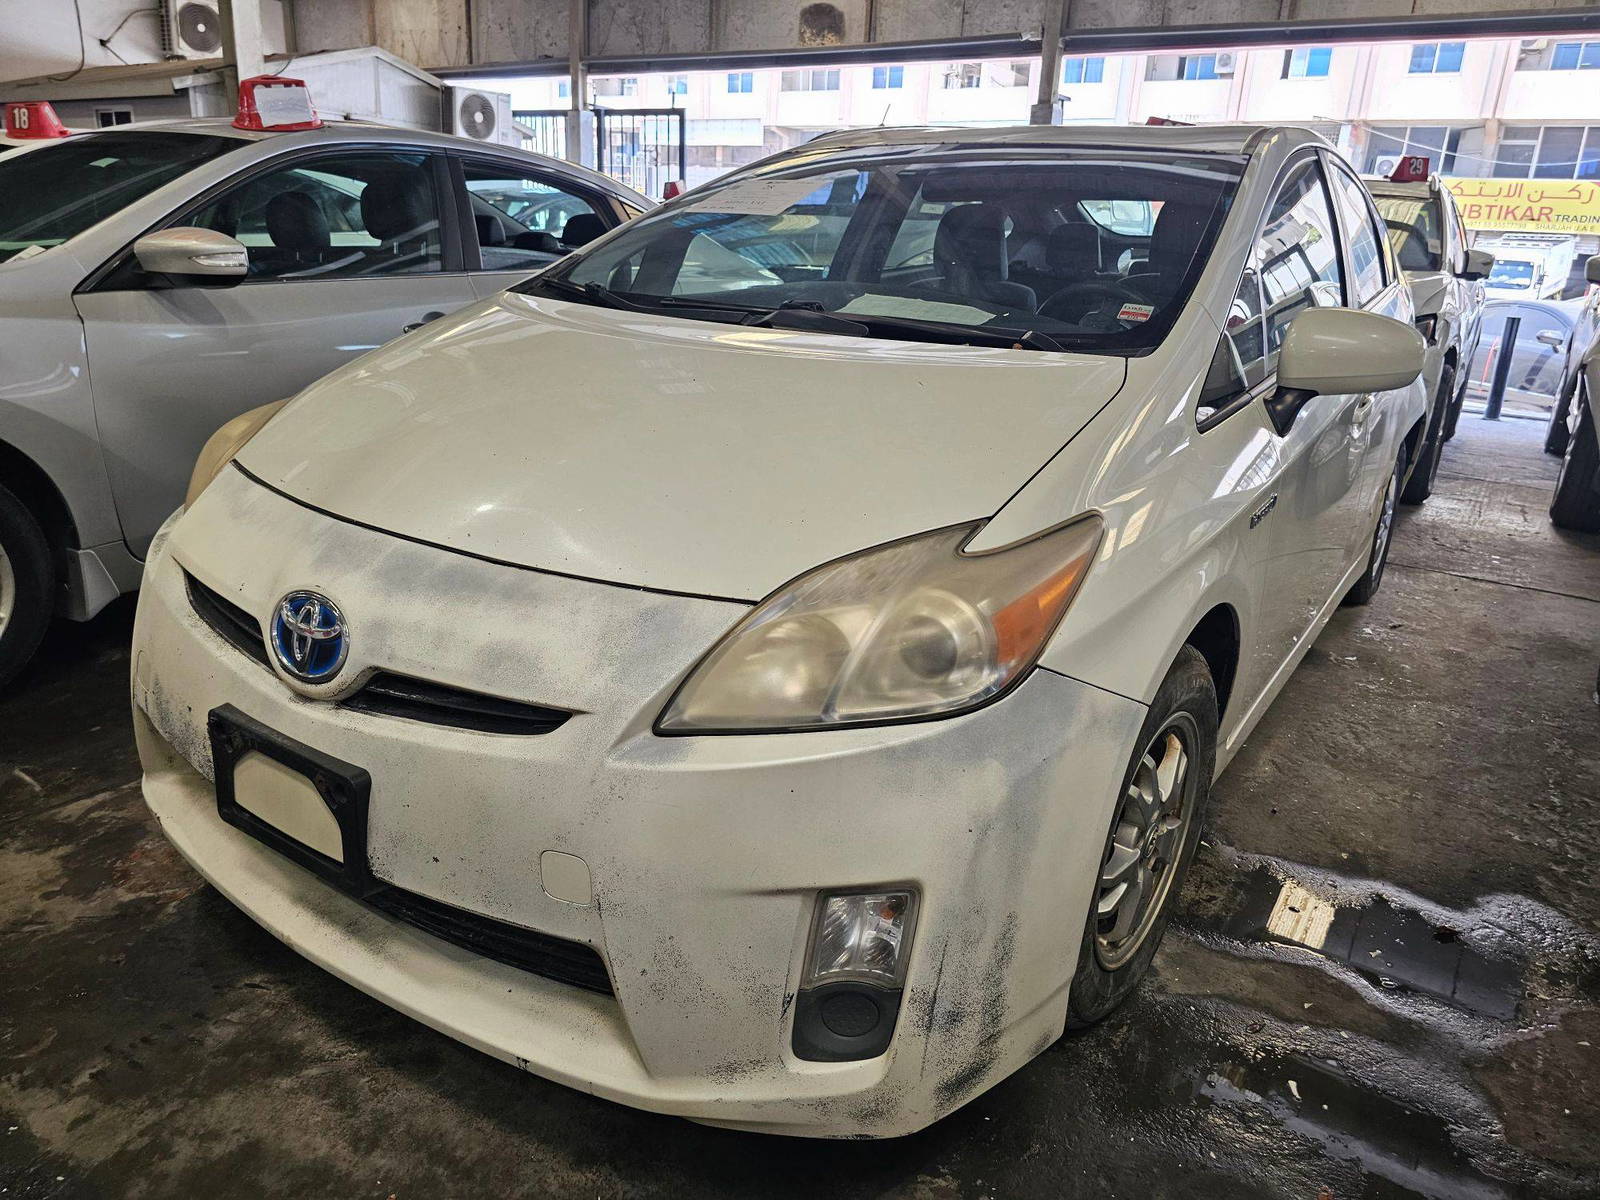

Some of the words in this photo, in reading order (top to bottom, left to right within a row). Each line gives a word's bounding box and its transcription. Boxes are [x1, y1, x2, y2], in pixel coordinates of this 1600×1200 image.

[13, 107, 29, 129] 18
[1410, 158, 1424, 175] 29
[1451, 181, 1523, 201] الابتك
[1527, 184, 1594, 205] ركن
[1555, 214, 1600, 224] TRADIN
